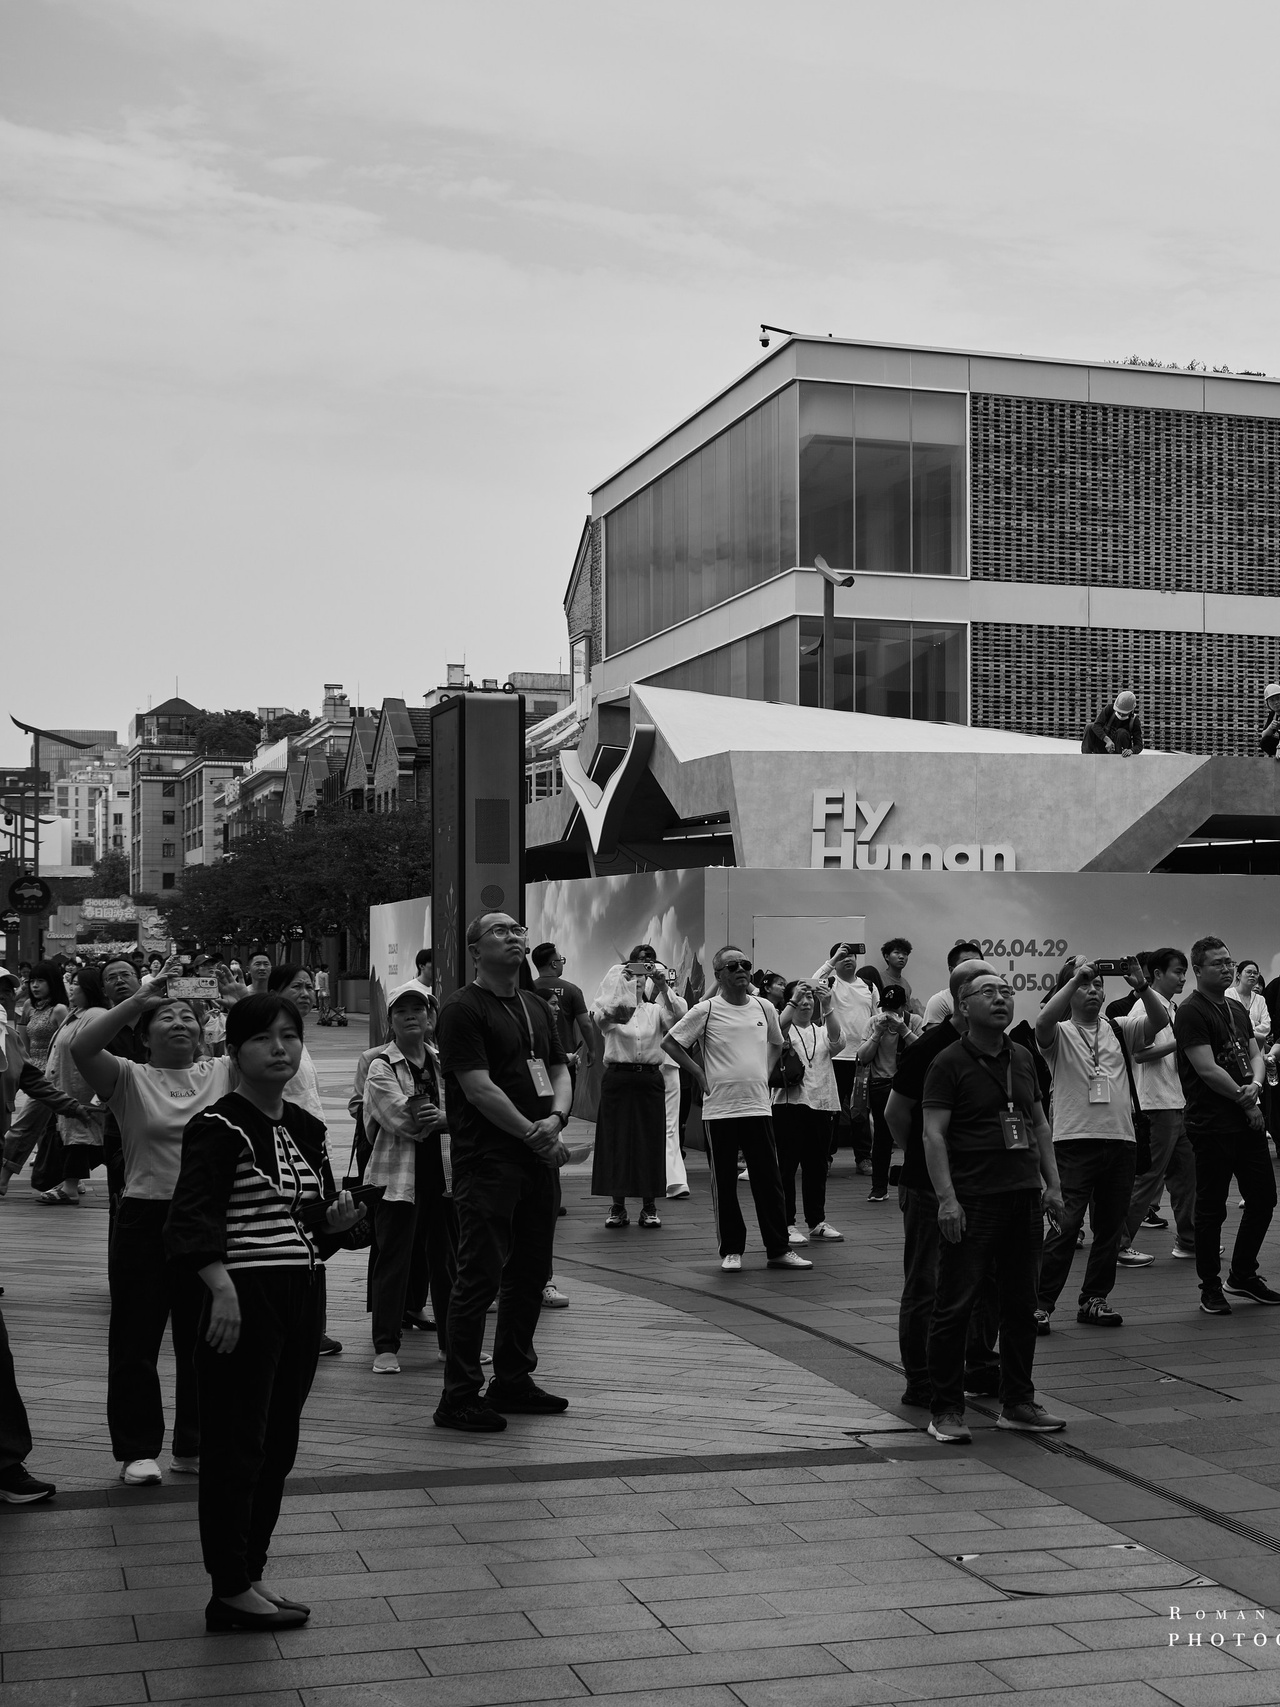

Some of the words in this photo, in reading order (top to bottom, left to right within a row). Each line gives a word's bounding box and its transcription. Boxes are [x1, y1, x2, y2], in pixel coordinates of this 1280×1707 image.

[813, 788, 896, 845] Fly
[810, 831, 1016, 871] Human
[84, 898, 121, 907] CHOUCHOU
[170, 1090, 196, 1098] RELAX
